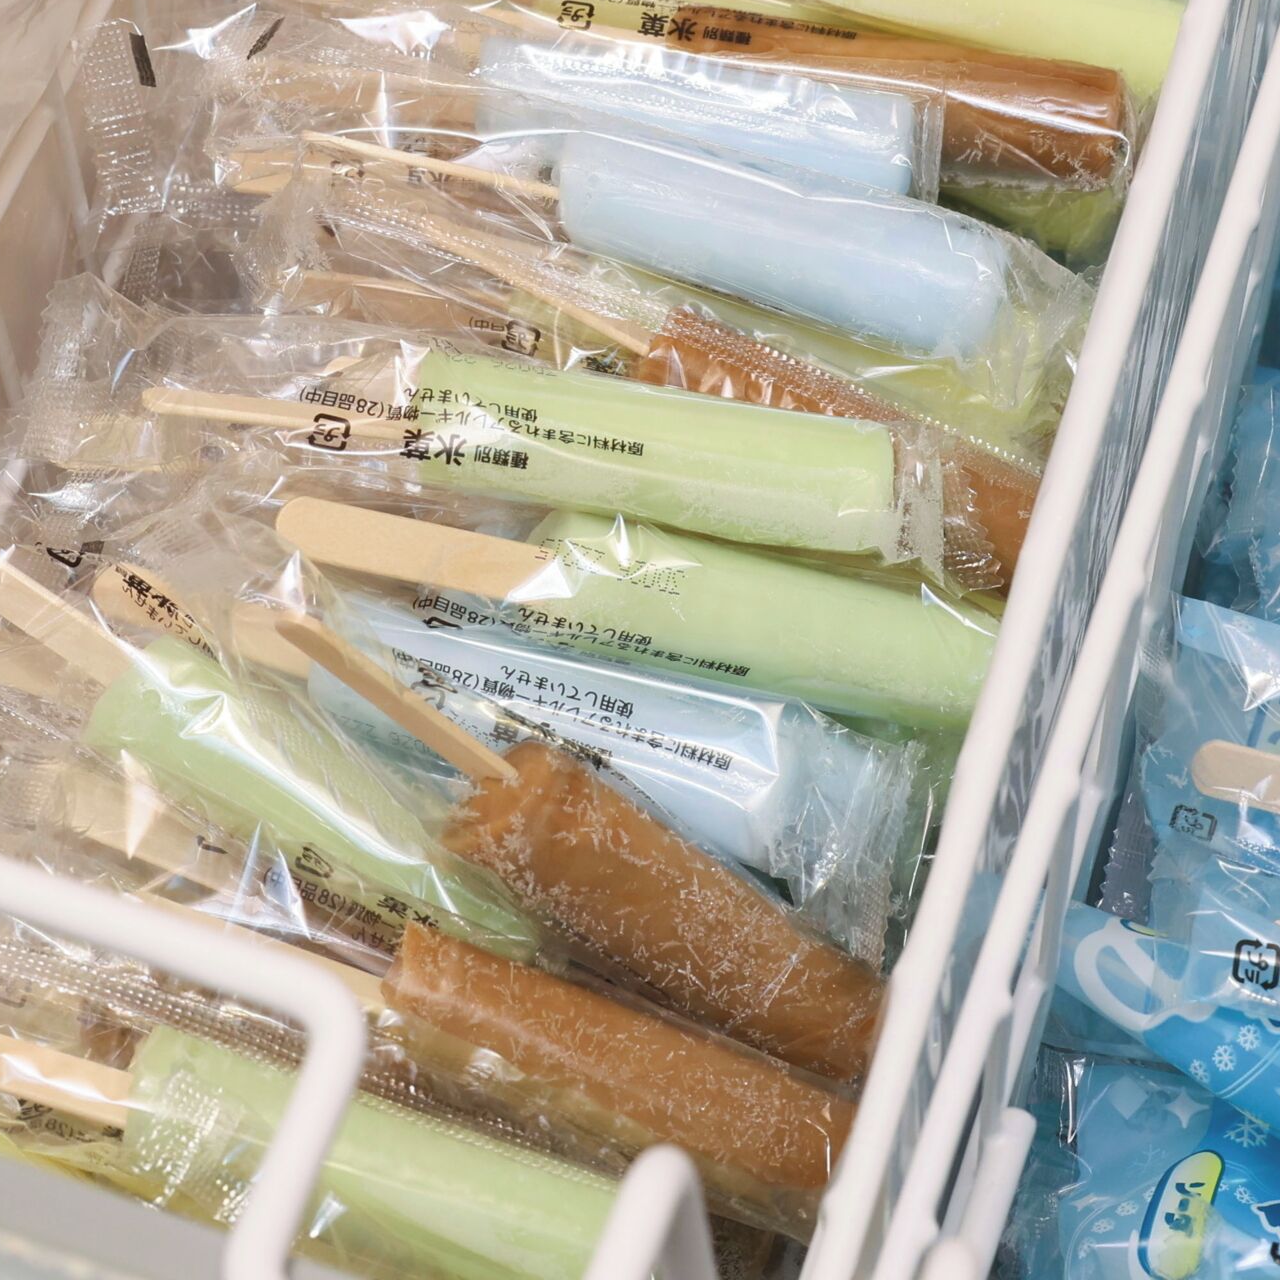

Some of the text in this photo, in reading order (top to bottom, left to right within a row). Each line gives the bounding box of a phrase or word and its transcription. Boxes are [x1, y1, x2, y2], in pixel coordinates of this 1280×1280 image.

[403, 385, 539, 424] 使用していません
[398, 429, 468, 466] 氷菓
[499, 664, 636, 720] 使用していません
